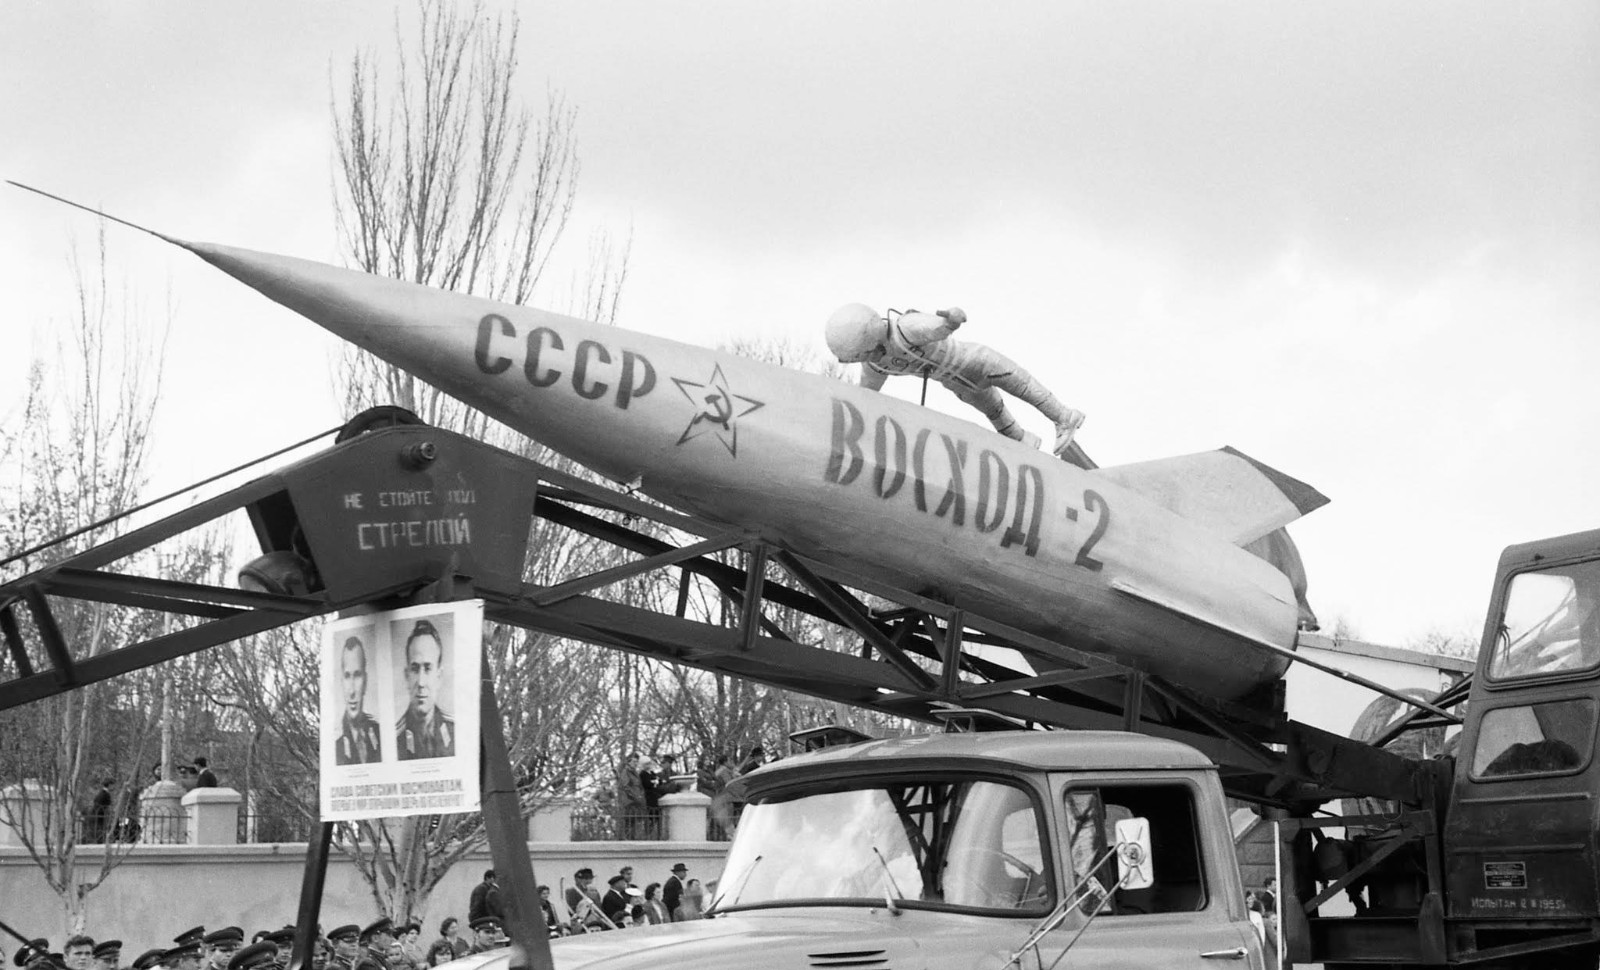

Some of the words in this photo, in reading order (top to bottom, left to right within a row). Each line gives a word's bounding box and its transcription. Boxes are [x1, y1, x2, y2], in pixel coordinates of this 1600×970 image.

[474, 313, 657, 410] СССР
[344, 493, 363, 509] НЕ
[358, 512, 470, 550] СТРЕЛОЙ
